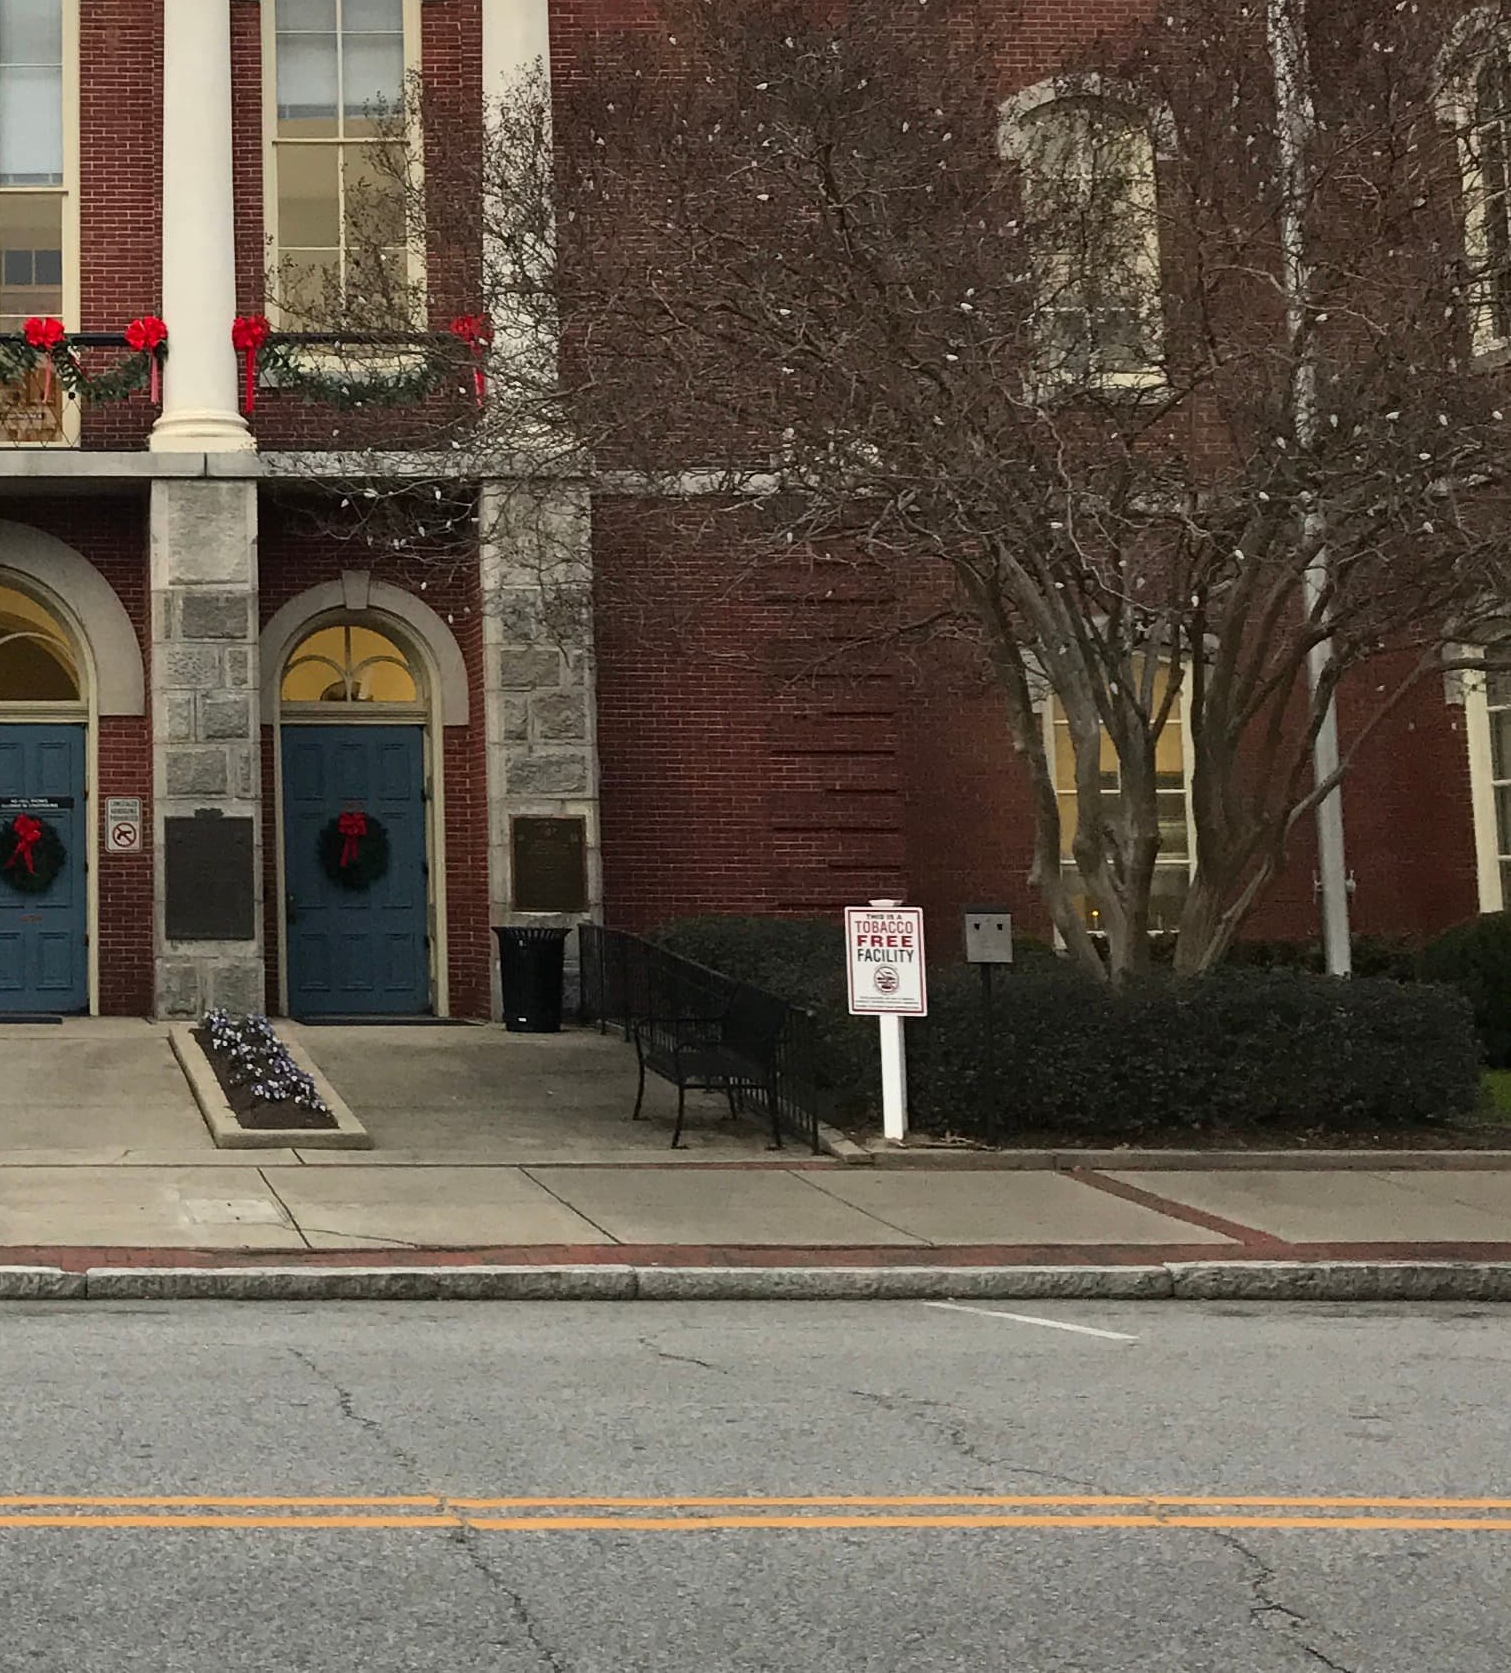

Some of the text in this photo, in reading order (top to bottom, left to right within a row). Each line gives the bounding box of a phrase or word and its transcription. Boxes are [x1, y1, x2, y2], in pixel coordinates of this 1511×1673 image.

[855, 920, 914, 934] TOBACCO
[857, 935, 913, 948] FREE
[857, 949, 914, 962] FACILITY
